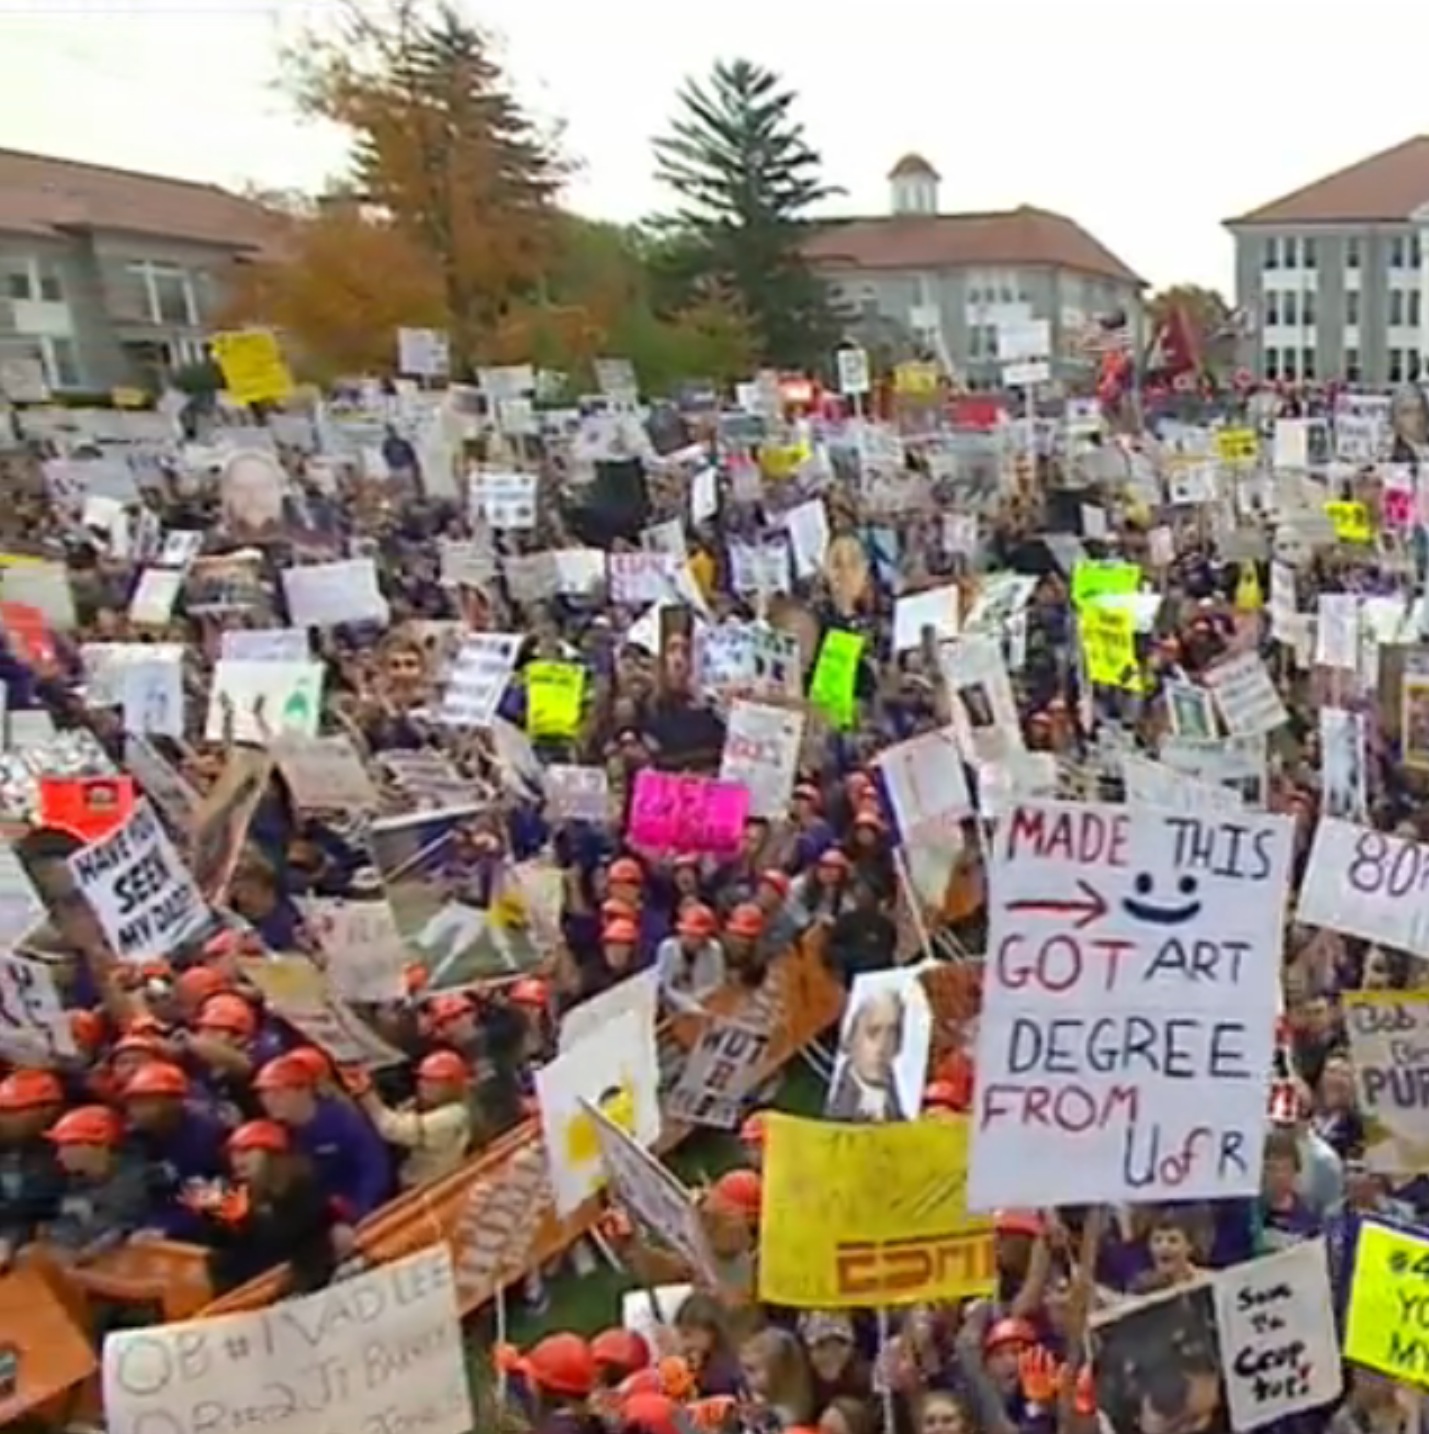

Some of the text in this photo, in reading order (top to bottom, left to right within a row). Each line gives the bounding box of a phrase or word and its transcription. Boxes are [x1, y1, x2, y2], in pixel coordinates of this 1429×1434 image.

[1006, 805, 1277, 881] MADE THIS
[997, 934, 1254, 992] GOT ART
[1008, 1015, 1253, 1080] DEGREE
[980, 1083, 1140, 1133] FROM
[391, 1255, 448, 1306] LEE
